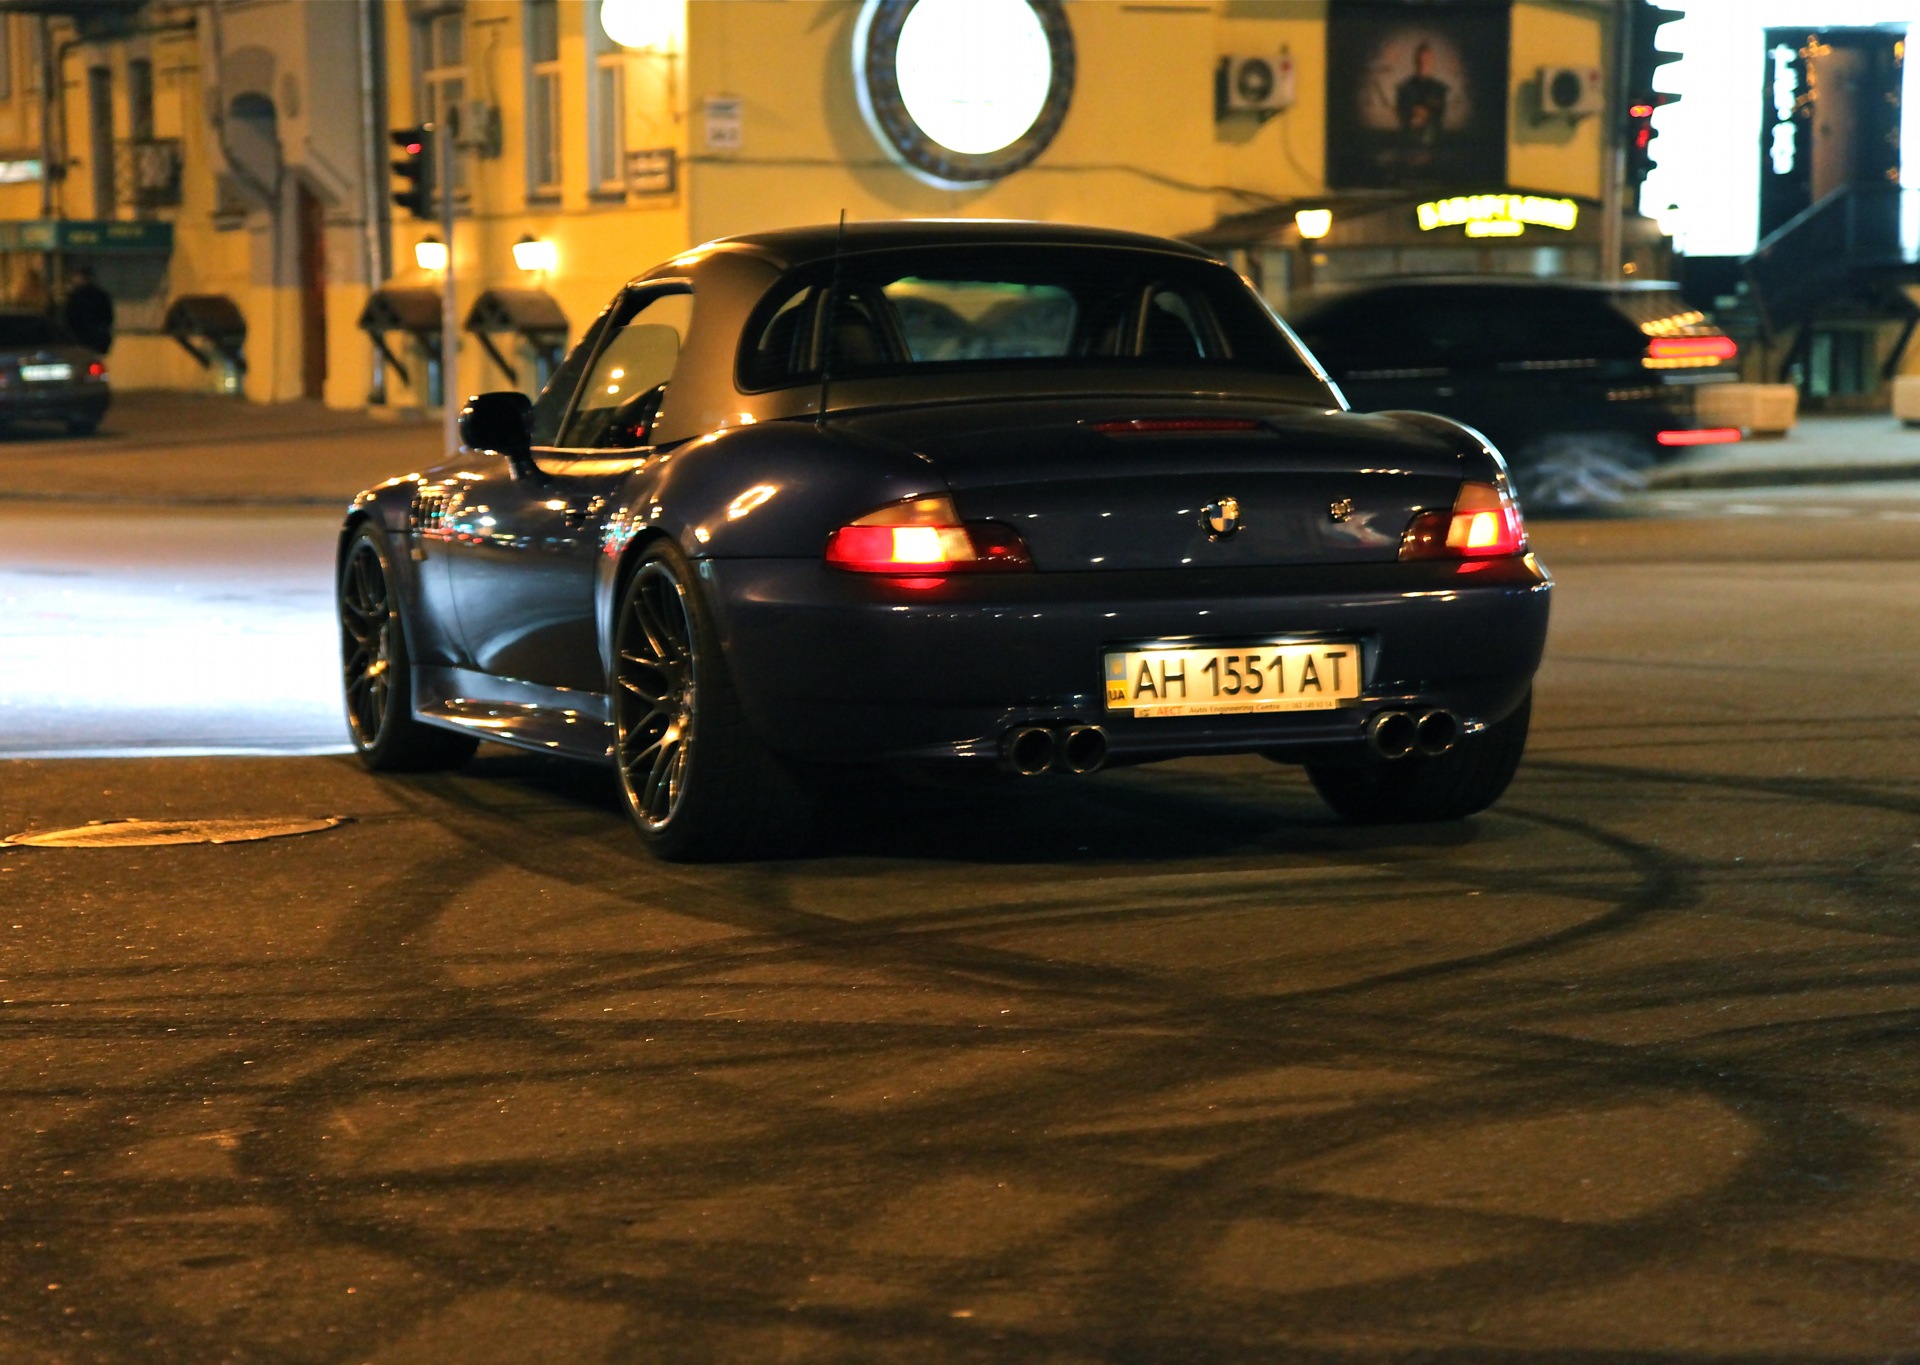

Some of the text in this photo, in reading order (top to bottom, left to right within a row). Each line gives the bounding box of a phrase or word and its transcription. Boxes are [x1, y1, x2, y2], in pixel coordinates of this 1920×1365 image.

[1133, 651, 1347, 699] AH 1551 AT
[1109, 689, 1126, 701] UA
[1156, 705, 1183, 716] AECT
[1189, 706, 1208, 714] Auto
[1210, 703, 1254, 714] Engineering
